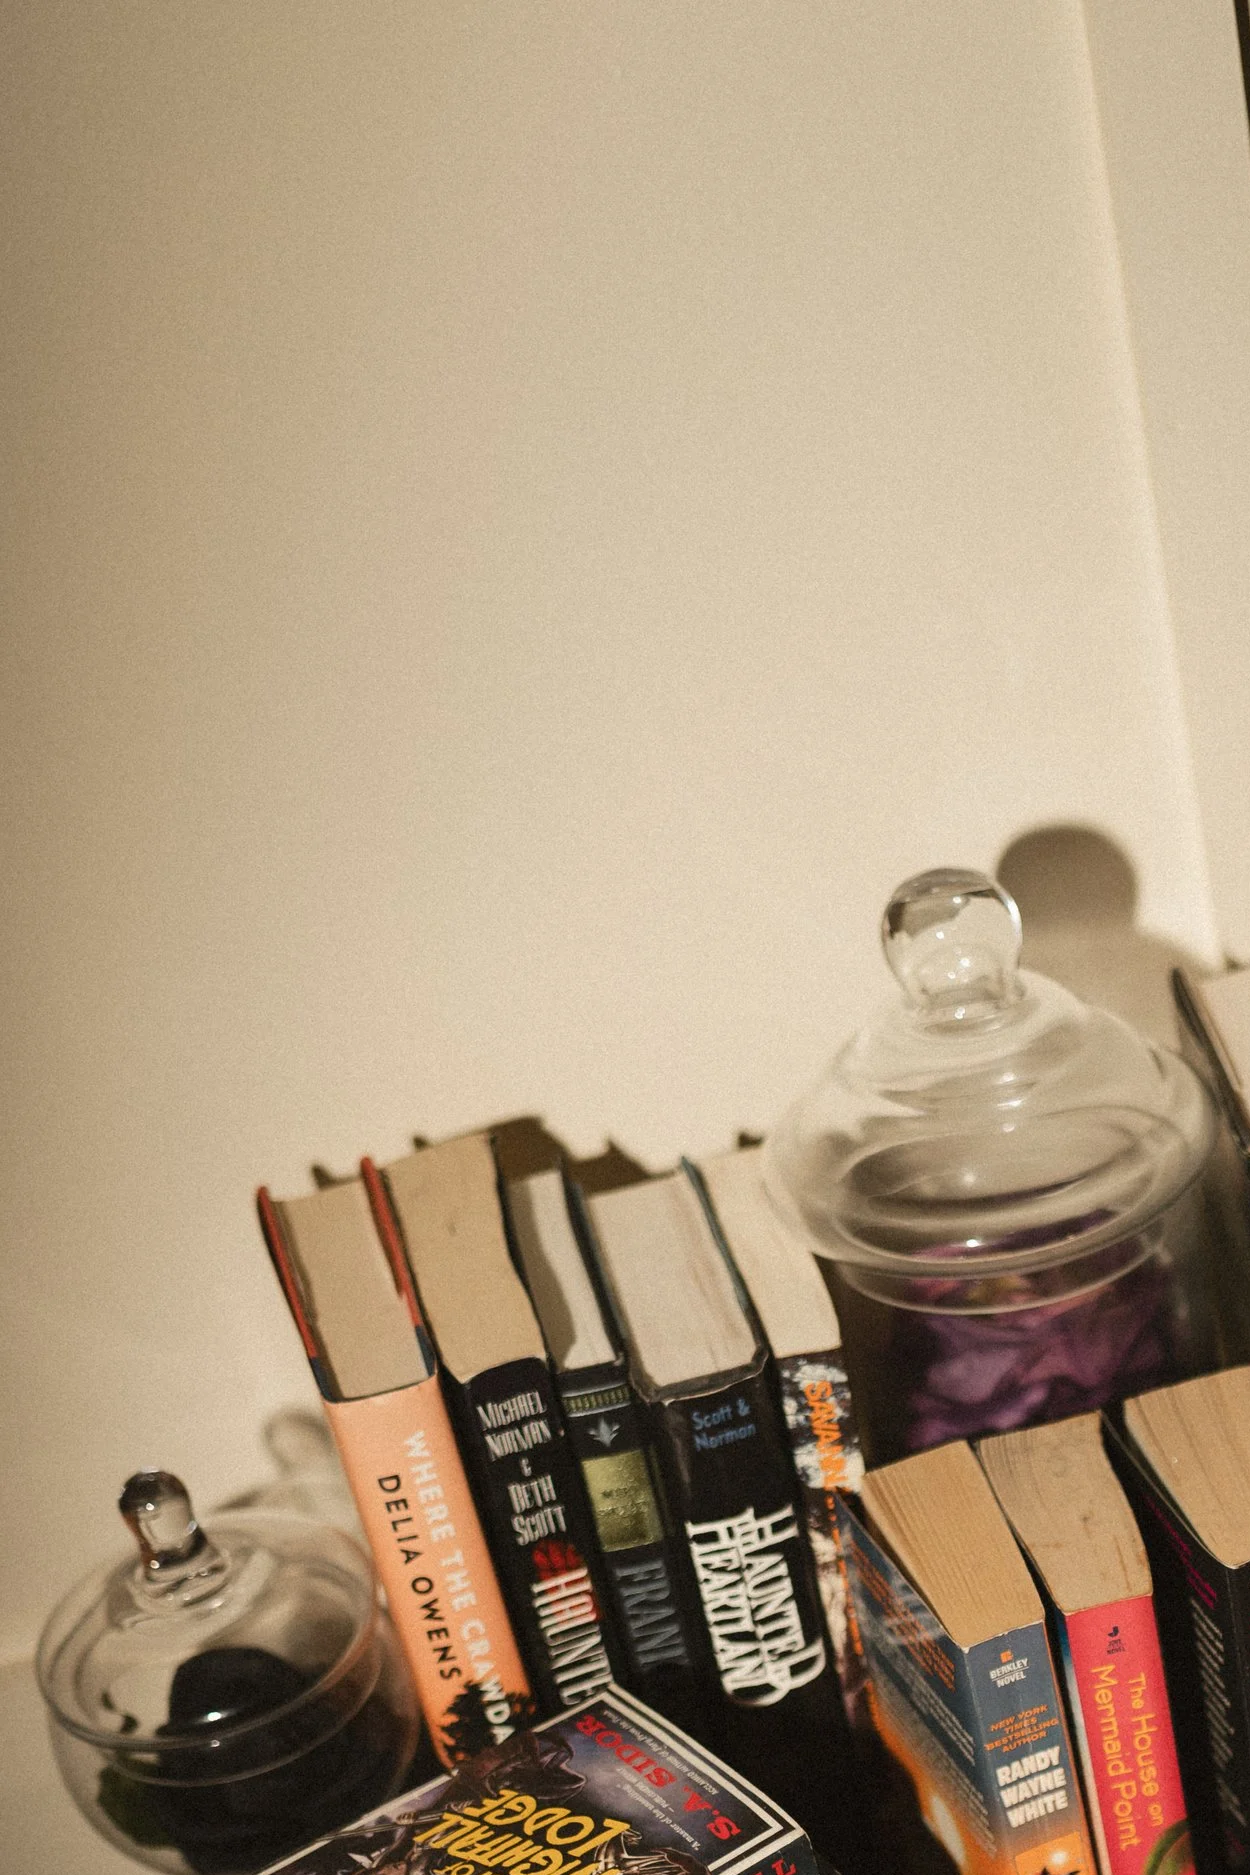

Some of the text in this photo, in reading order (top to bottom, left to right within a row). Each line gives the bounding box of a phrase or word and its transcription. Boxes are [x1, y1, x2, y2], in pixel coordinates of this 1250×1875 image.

[475, 1392, 549, 1431] MICHAEL
[692, 1404, 732, 1431] Scott
[484, 1420, 552, 1462] NORMAN
[694, 1423, 757, 1452] Norman
[508, 1474, 557, 1514] BETH
[511, 1504, 567, 1546] SCOTT
[378, 1474, 462, 1681] DELIA OWENS
[403, 1430, 515, 1745] WHERE THE CRAWDA
[741, 1503, 826, 1690] HAUNTED
[685, 1505, 795, 1707] HEARTLAND
[989, 1658, 1028, 1680] BERKLEY
[996, 1671, 1026, 1688] NOVEL
[984, 1718, 1059, 1751] BESTSELLING
[990, 1704, 1048, 1732] NEW YORK
[1004, 1717, 1037, 1734] TIMES
[1002, 1731, 1047, 1754] AUTHOR
[1090, 1664, 1141, 1850] Mermaid Point
[1128, 1672, 1164, 1826] The House on
[576, 1714, 742, 1841] S.A. SIDOR
[685, 1769, 720, 1797] ACCLAIMED
[996, 1746, 1061, 1787] RANDY
[1000, 1768, 1066, 1808] WAYNE
[464, 1789, 630, 1857] LODGE
[650, 1806, 695, 1844] master of the
[1005, 1790, 1068, 1828] WHITE
